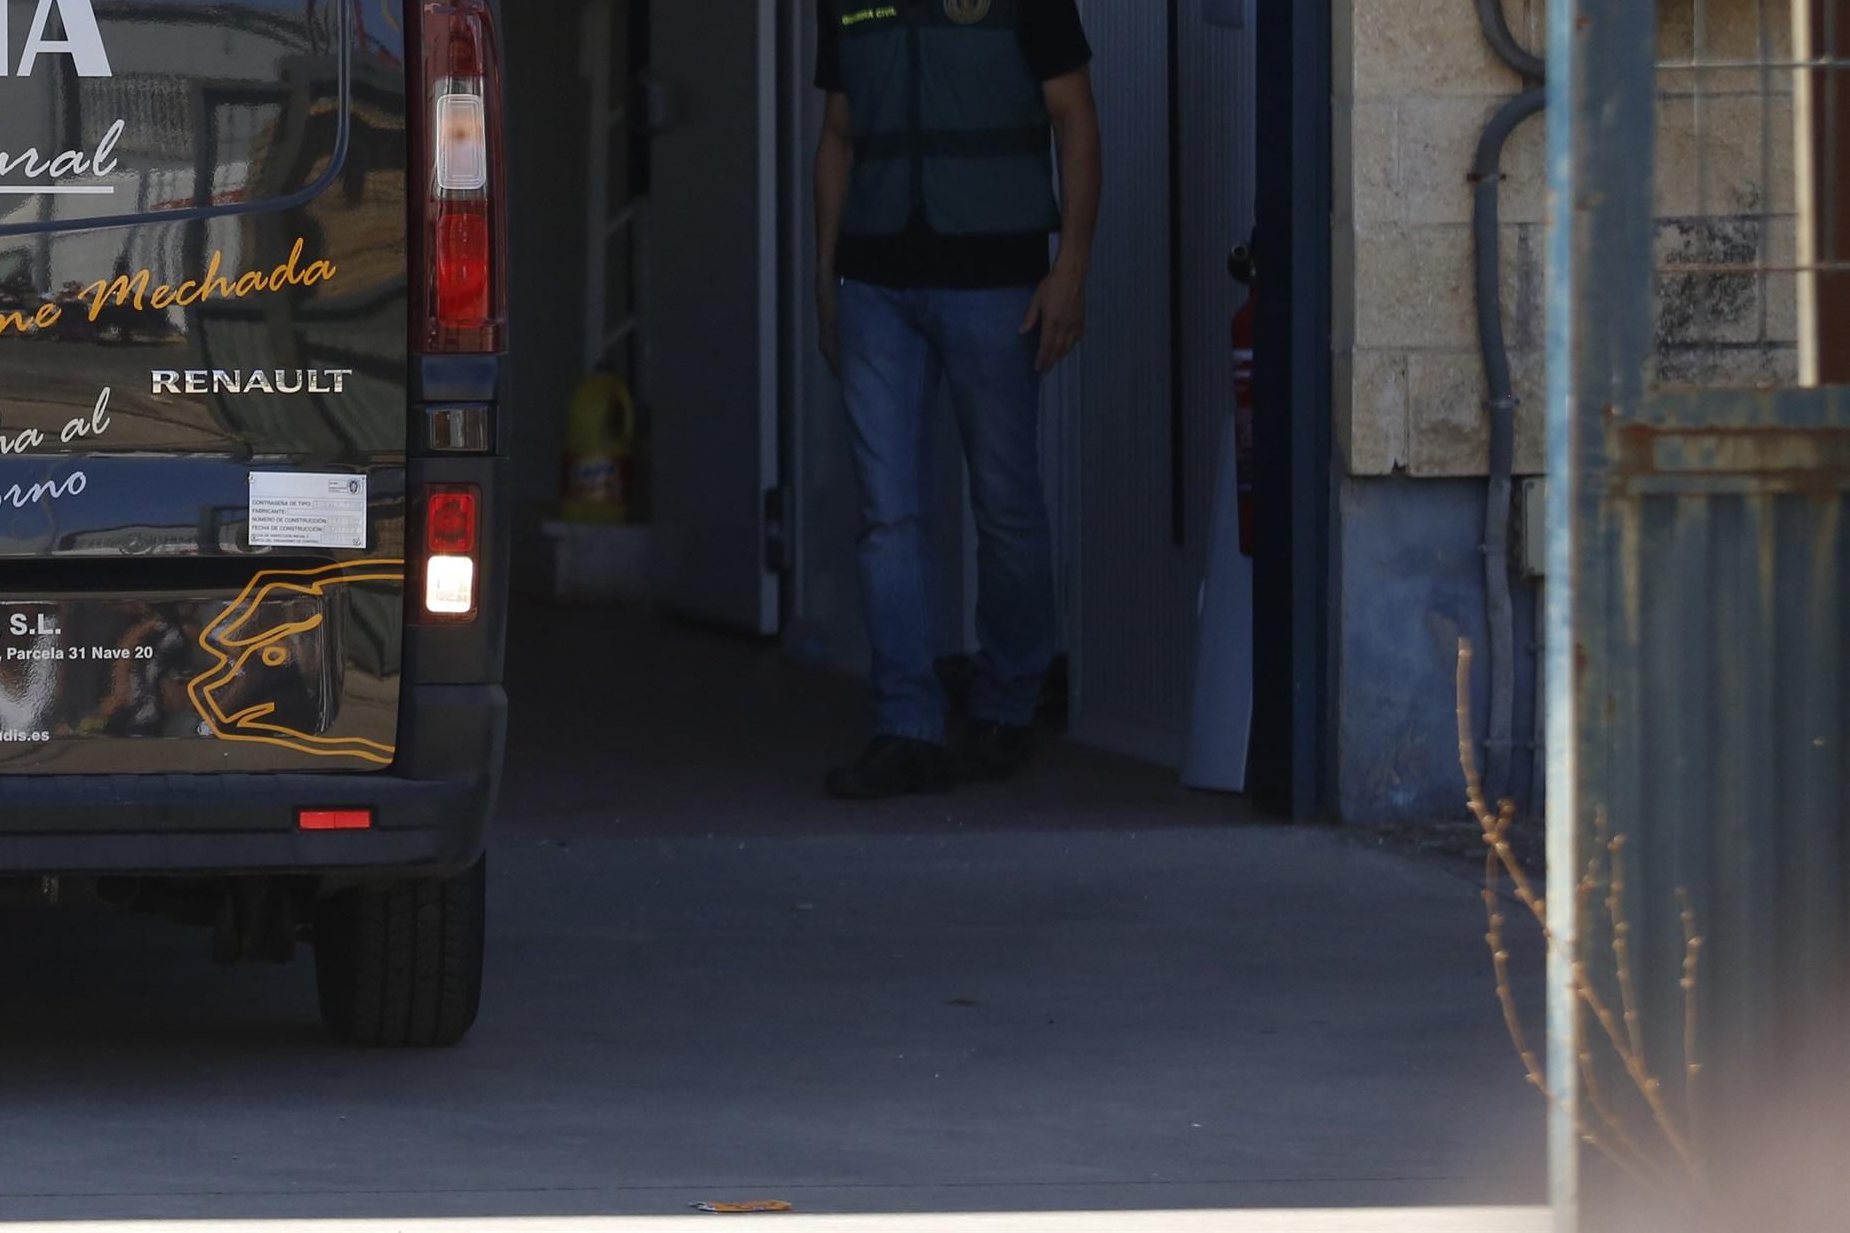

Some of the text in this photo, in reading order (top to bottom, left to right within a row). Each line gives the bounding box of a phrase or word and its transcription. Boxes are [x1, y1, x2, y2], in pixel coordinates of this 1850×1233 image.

[77, 236, 337, 323] Mechada
[150, 368, 353, 395] RENAULT
[60, 386, 111, 444] al
[9, 613, 62, 636] S.L.
[6, 646, 65, 661] Parcela
[68, 646, 88, 660] 31
[91, 646, 130, 660] Nave
[134, 645, 154, 659] 20
